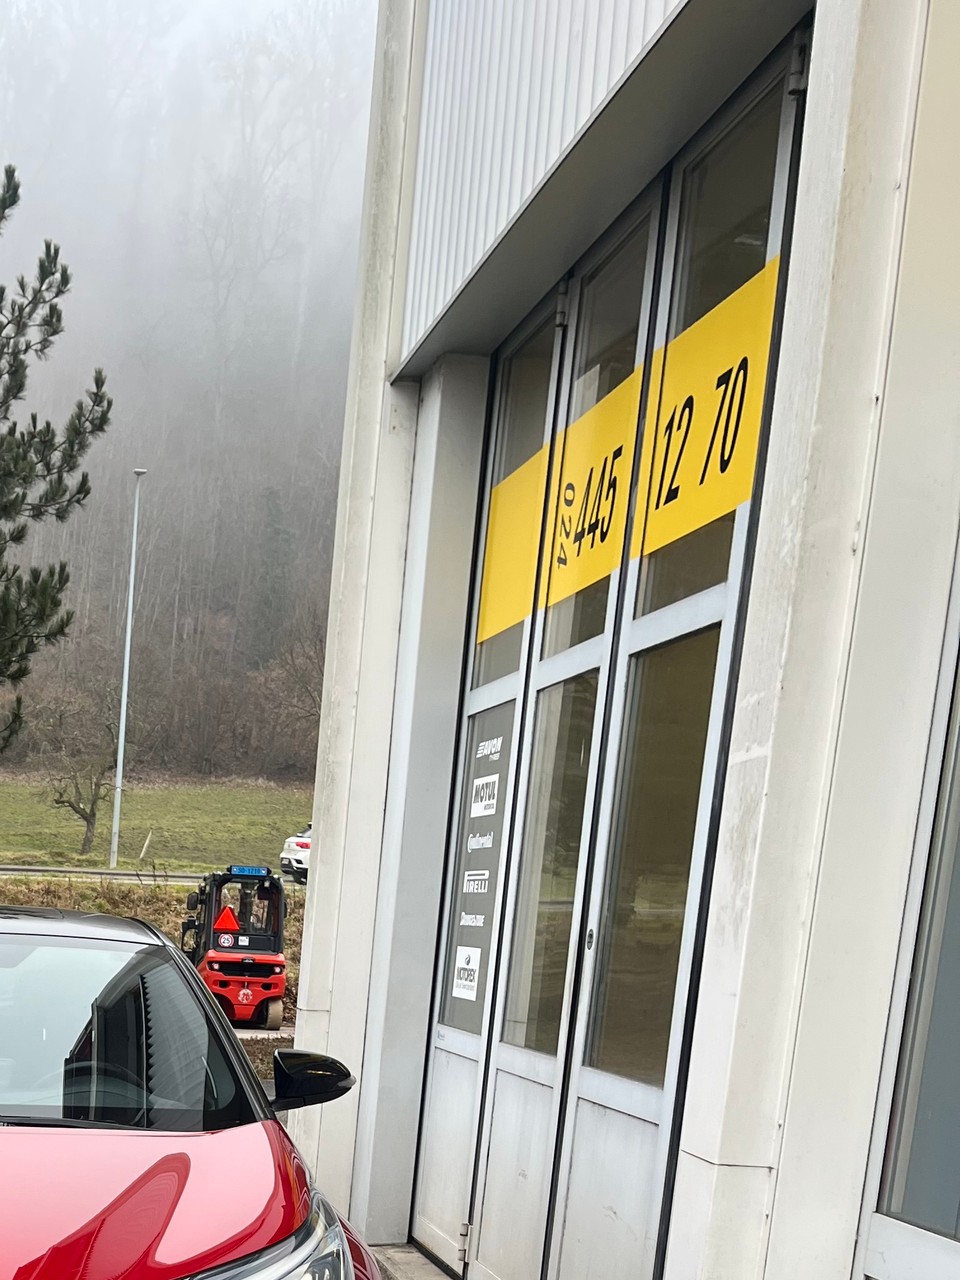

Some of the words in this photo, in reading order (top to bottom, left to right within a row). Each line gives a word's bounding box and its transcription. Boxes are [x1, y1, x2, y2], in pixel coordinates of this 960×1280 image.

[573, 444, 624, 557] 445
[655, 395, 695, 511] 12
[699, 356, 748, 487] 70
[557, 482, 575, 569] 024
[473, 781, 496, 803] MOTUL
[463, 870, 490, 893] PIRELLI
